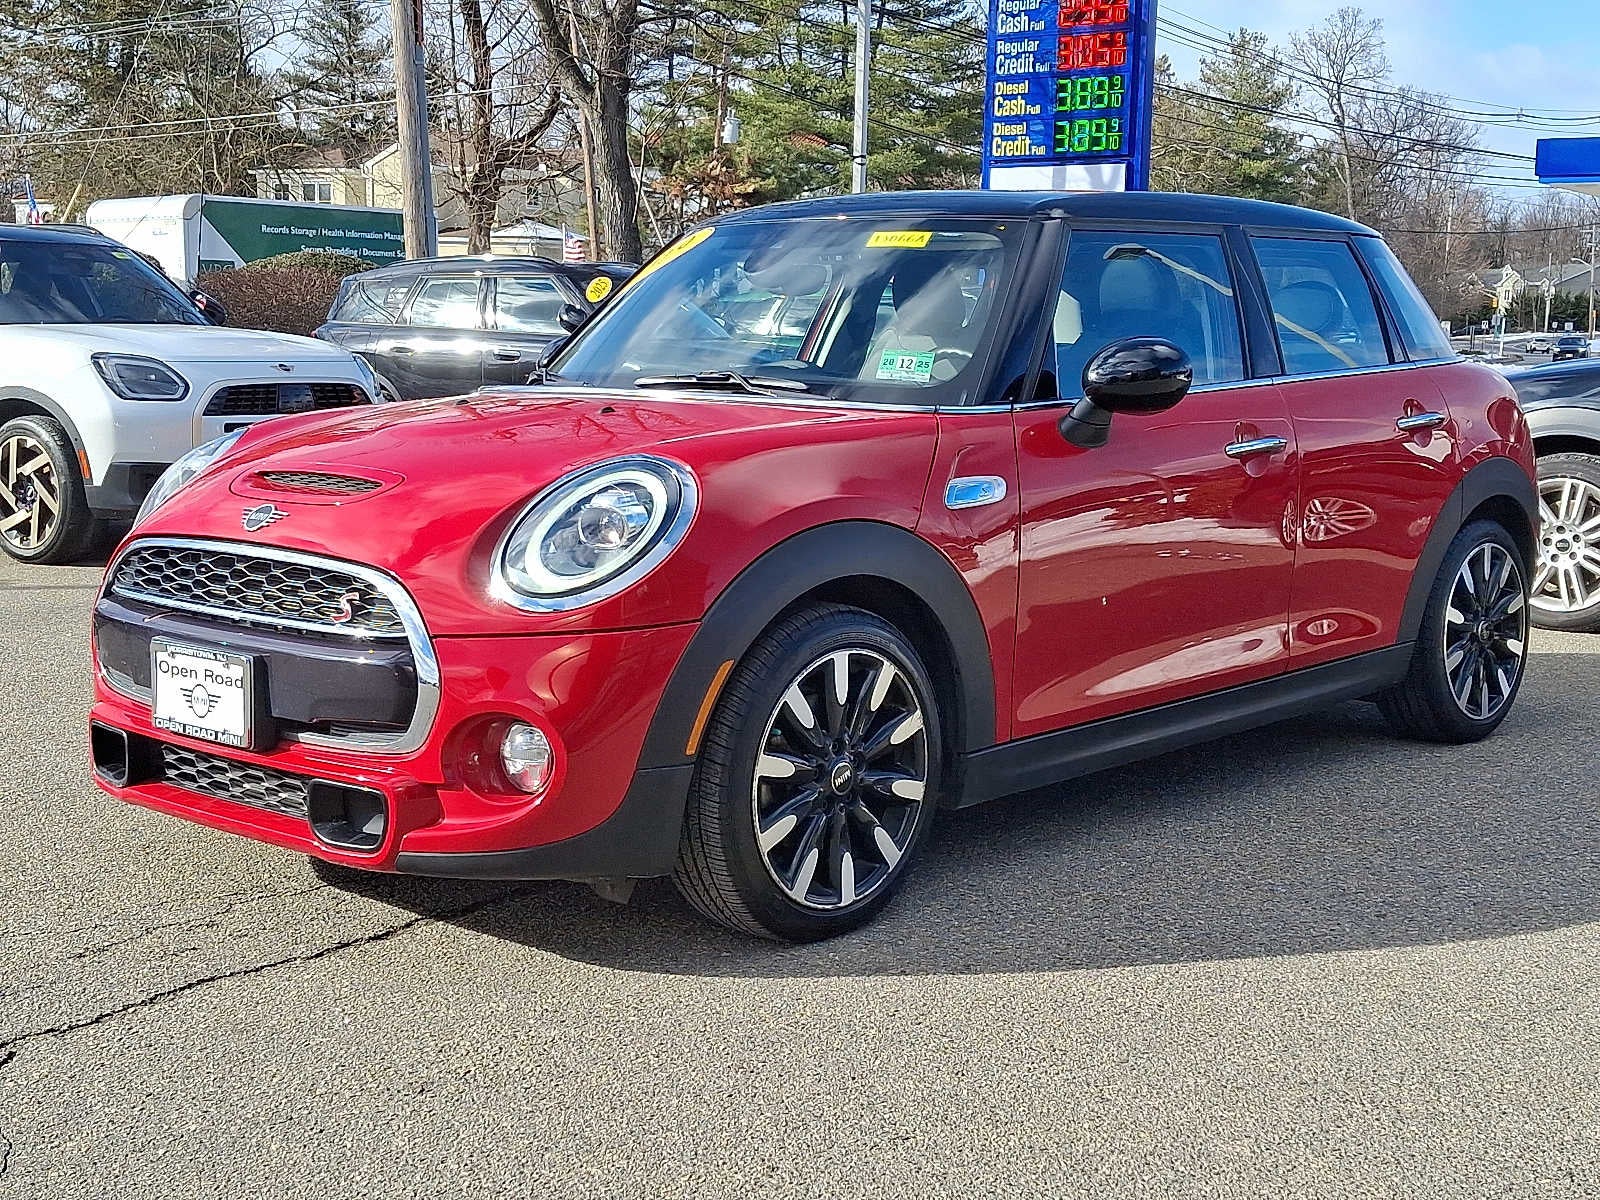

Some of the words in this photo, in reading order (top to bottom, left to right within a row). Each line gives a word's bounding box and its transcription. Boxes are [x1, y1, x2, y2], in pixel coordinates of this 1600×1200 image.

[998, 0, 1040, 14] Regular
[998, 12, 1029, 34] Cash
[1030, 20, 1045, 31] Full
[996, 39, 1040, 56] Regular
[996, 53, 1034, 75] Credit
[1035, 62, 1050, 72] Full
[994, 80, 1029, 95] Diesel
[994, 96, 1026, 116] Cash
[1026, 105, 1041, 115] Full
[992, 122, 1027, 135] Diesel
[1055, 119, 1106, 152] 3.89
[992, 136, 1031, 157] Credit
[1031, 145, 1046, 156] Full
[261, 224, 290, 234] Records
[290, 226, 317, 237] Storage
[321, 228, 345, 237] Health
[345, 229, 383, 239] Information
[300, 245, 324, 253] Secure
[325, 246, 359, 257] Shredding
[362, 248, 396, 257] Document
[882, 358, 895, 366] 20
[899, 358, 914, 369] 12
[917, 360, 931, 369] 25
[159, 660, 198, 679] Open
[204, 669, 244, 689] Road
[155, 719, 183, 732] OPEN
[186, 724, 216, 739] ROAD
[218, 731, 241, 746] MINI
